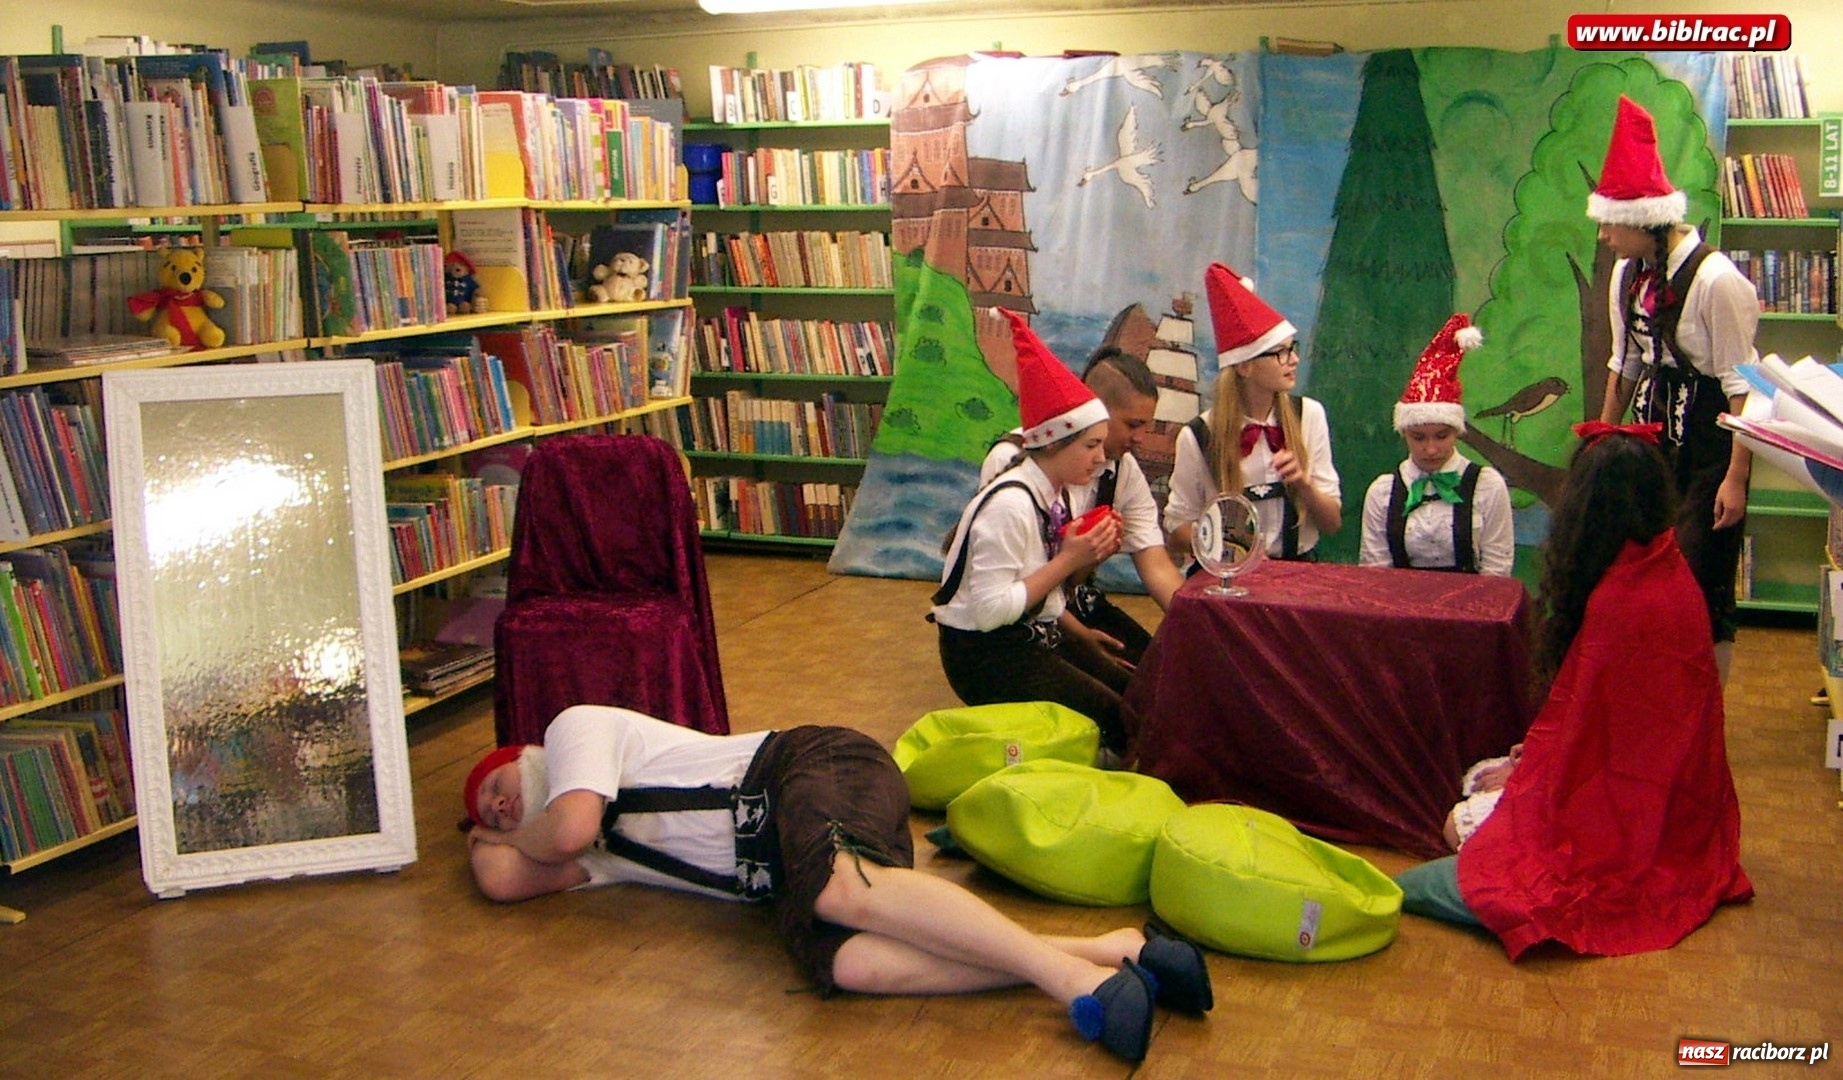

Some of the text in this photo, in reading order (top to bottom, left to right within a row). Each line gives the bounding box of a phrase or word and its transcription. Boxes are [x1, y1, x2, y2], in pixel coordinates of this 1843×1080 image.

[873, 99, 881, 114] D
[1824, 122, 1838, 189] 8-11 LAT
